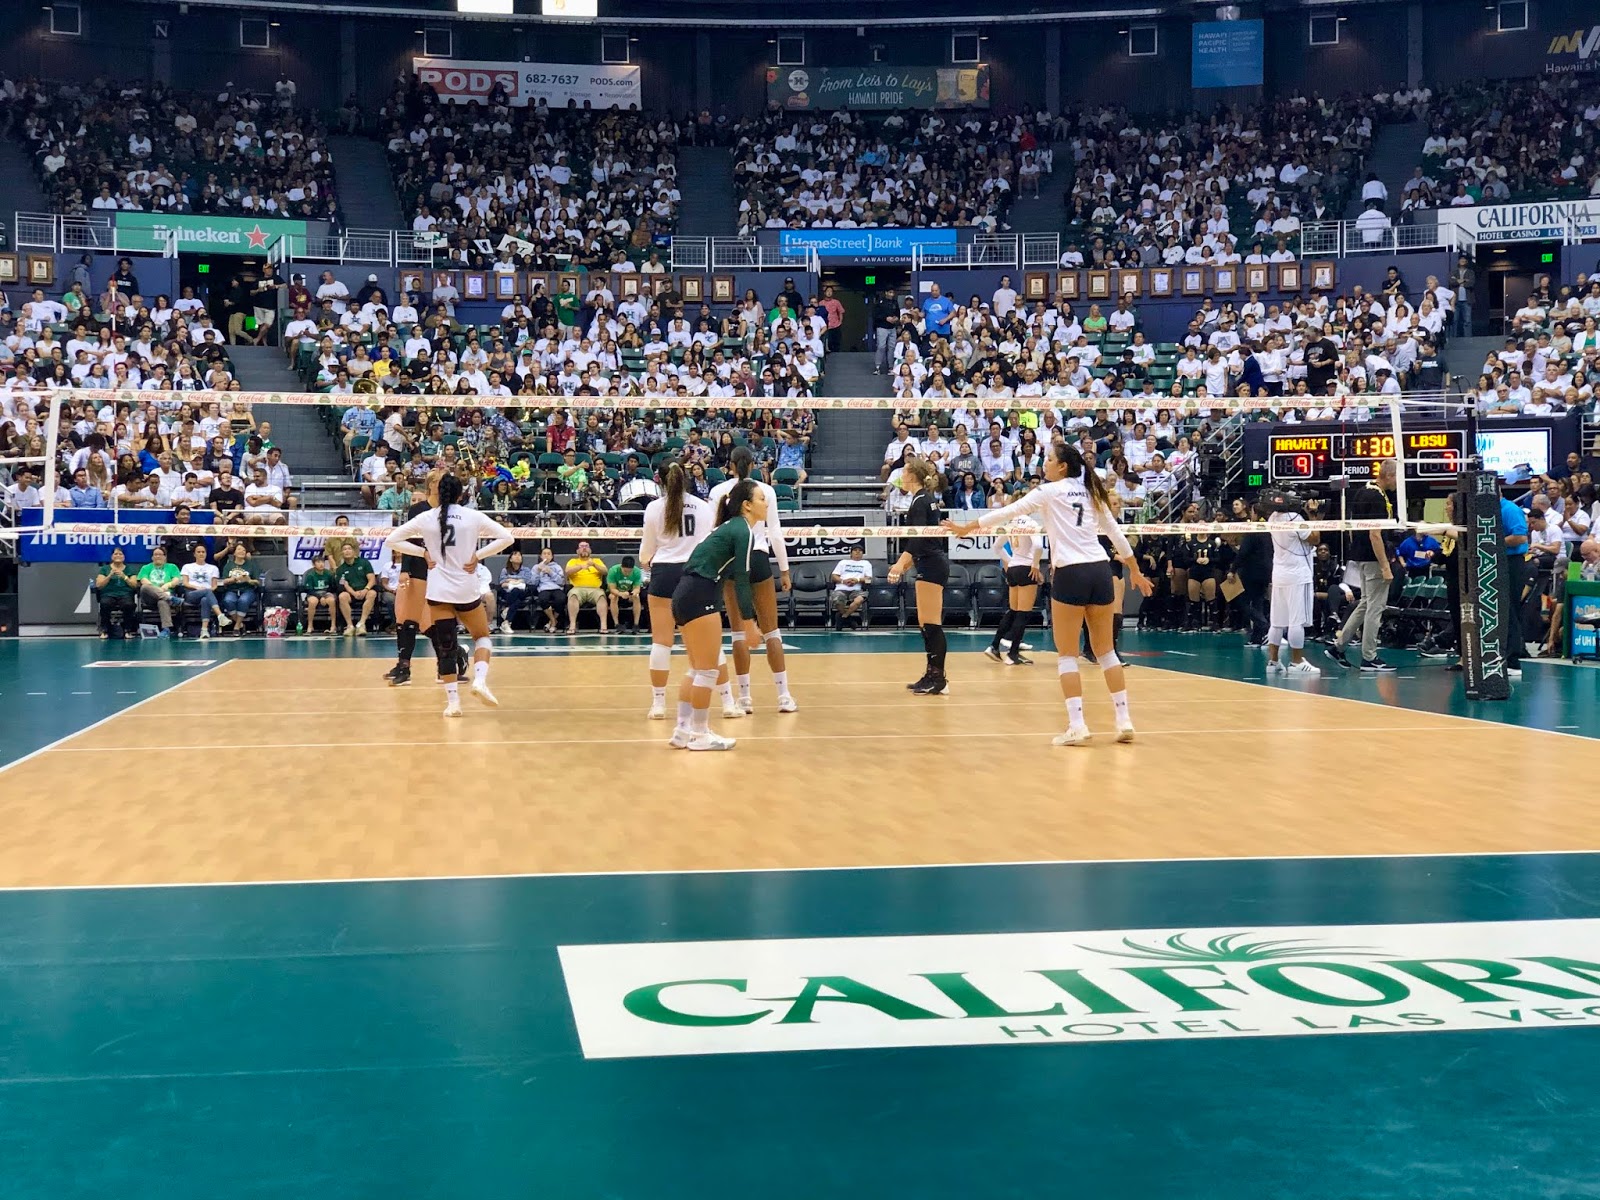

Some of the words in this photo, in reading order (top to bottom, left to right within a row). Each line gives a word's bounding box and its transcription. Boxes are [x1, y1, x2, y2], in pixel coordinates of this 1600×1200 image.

[156, 25, 167, 37] N
[421, 70, 516, 93] PODS
[525, 73, 579, 85] 682-7637
[590, 77, 633, 86] PODS.com
[819, 75, 852, 93] From
[856, 73, 882, 87] Leis
[885, 74, 897, 87] to
[902, 74, 933, 96] Lay's
[848, 92, 878, 104] HAWAII
[880, 92, 903, 104] PRIDE
[1477, 203, 1592, 228] CALIFORNIA
[153, 224, 240, 244] Hineken
[874, 236, 902, 249] Bank
[1479, 231, 1504, 240] HOTEL
[1510, 229, 1541, 238] CASINO
[1547, 228, 1564, 237] LAS
[1275, 438, 1328, 451] HAWAI'I
[1356, 436, 1394, 456] 1:30
[1410, 434, 1447, 447] LBSU
[1297, 456, 1308, 474] 9
[1443, 453, 1454, 470] 7
[1343, 466, 1370, 474] PERIOD
[1072, 503, 1084, 526] 7
[443, 524, 456, 546] 2
[679, 514, 696, 537] 10
[1575, 635, 1581, 646] of
[1582, 636, 1591, 646] UH
[999, 1019, 1260, 1039] HOTEL
[1294, 1012, 1446, 1029] LAS
